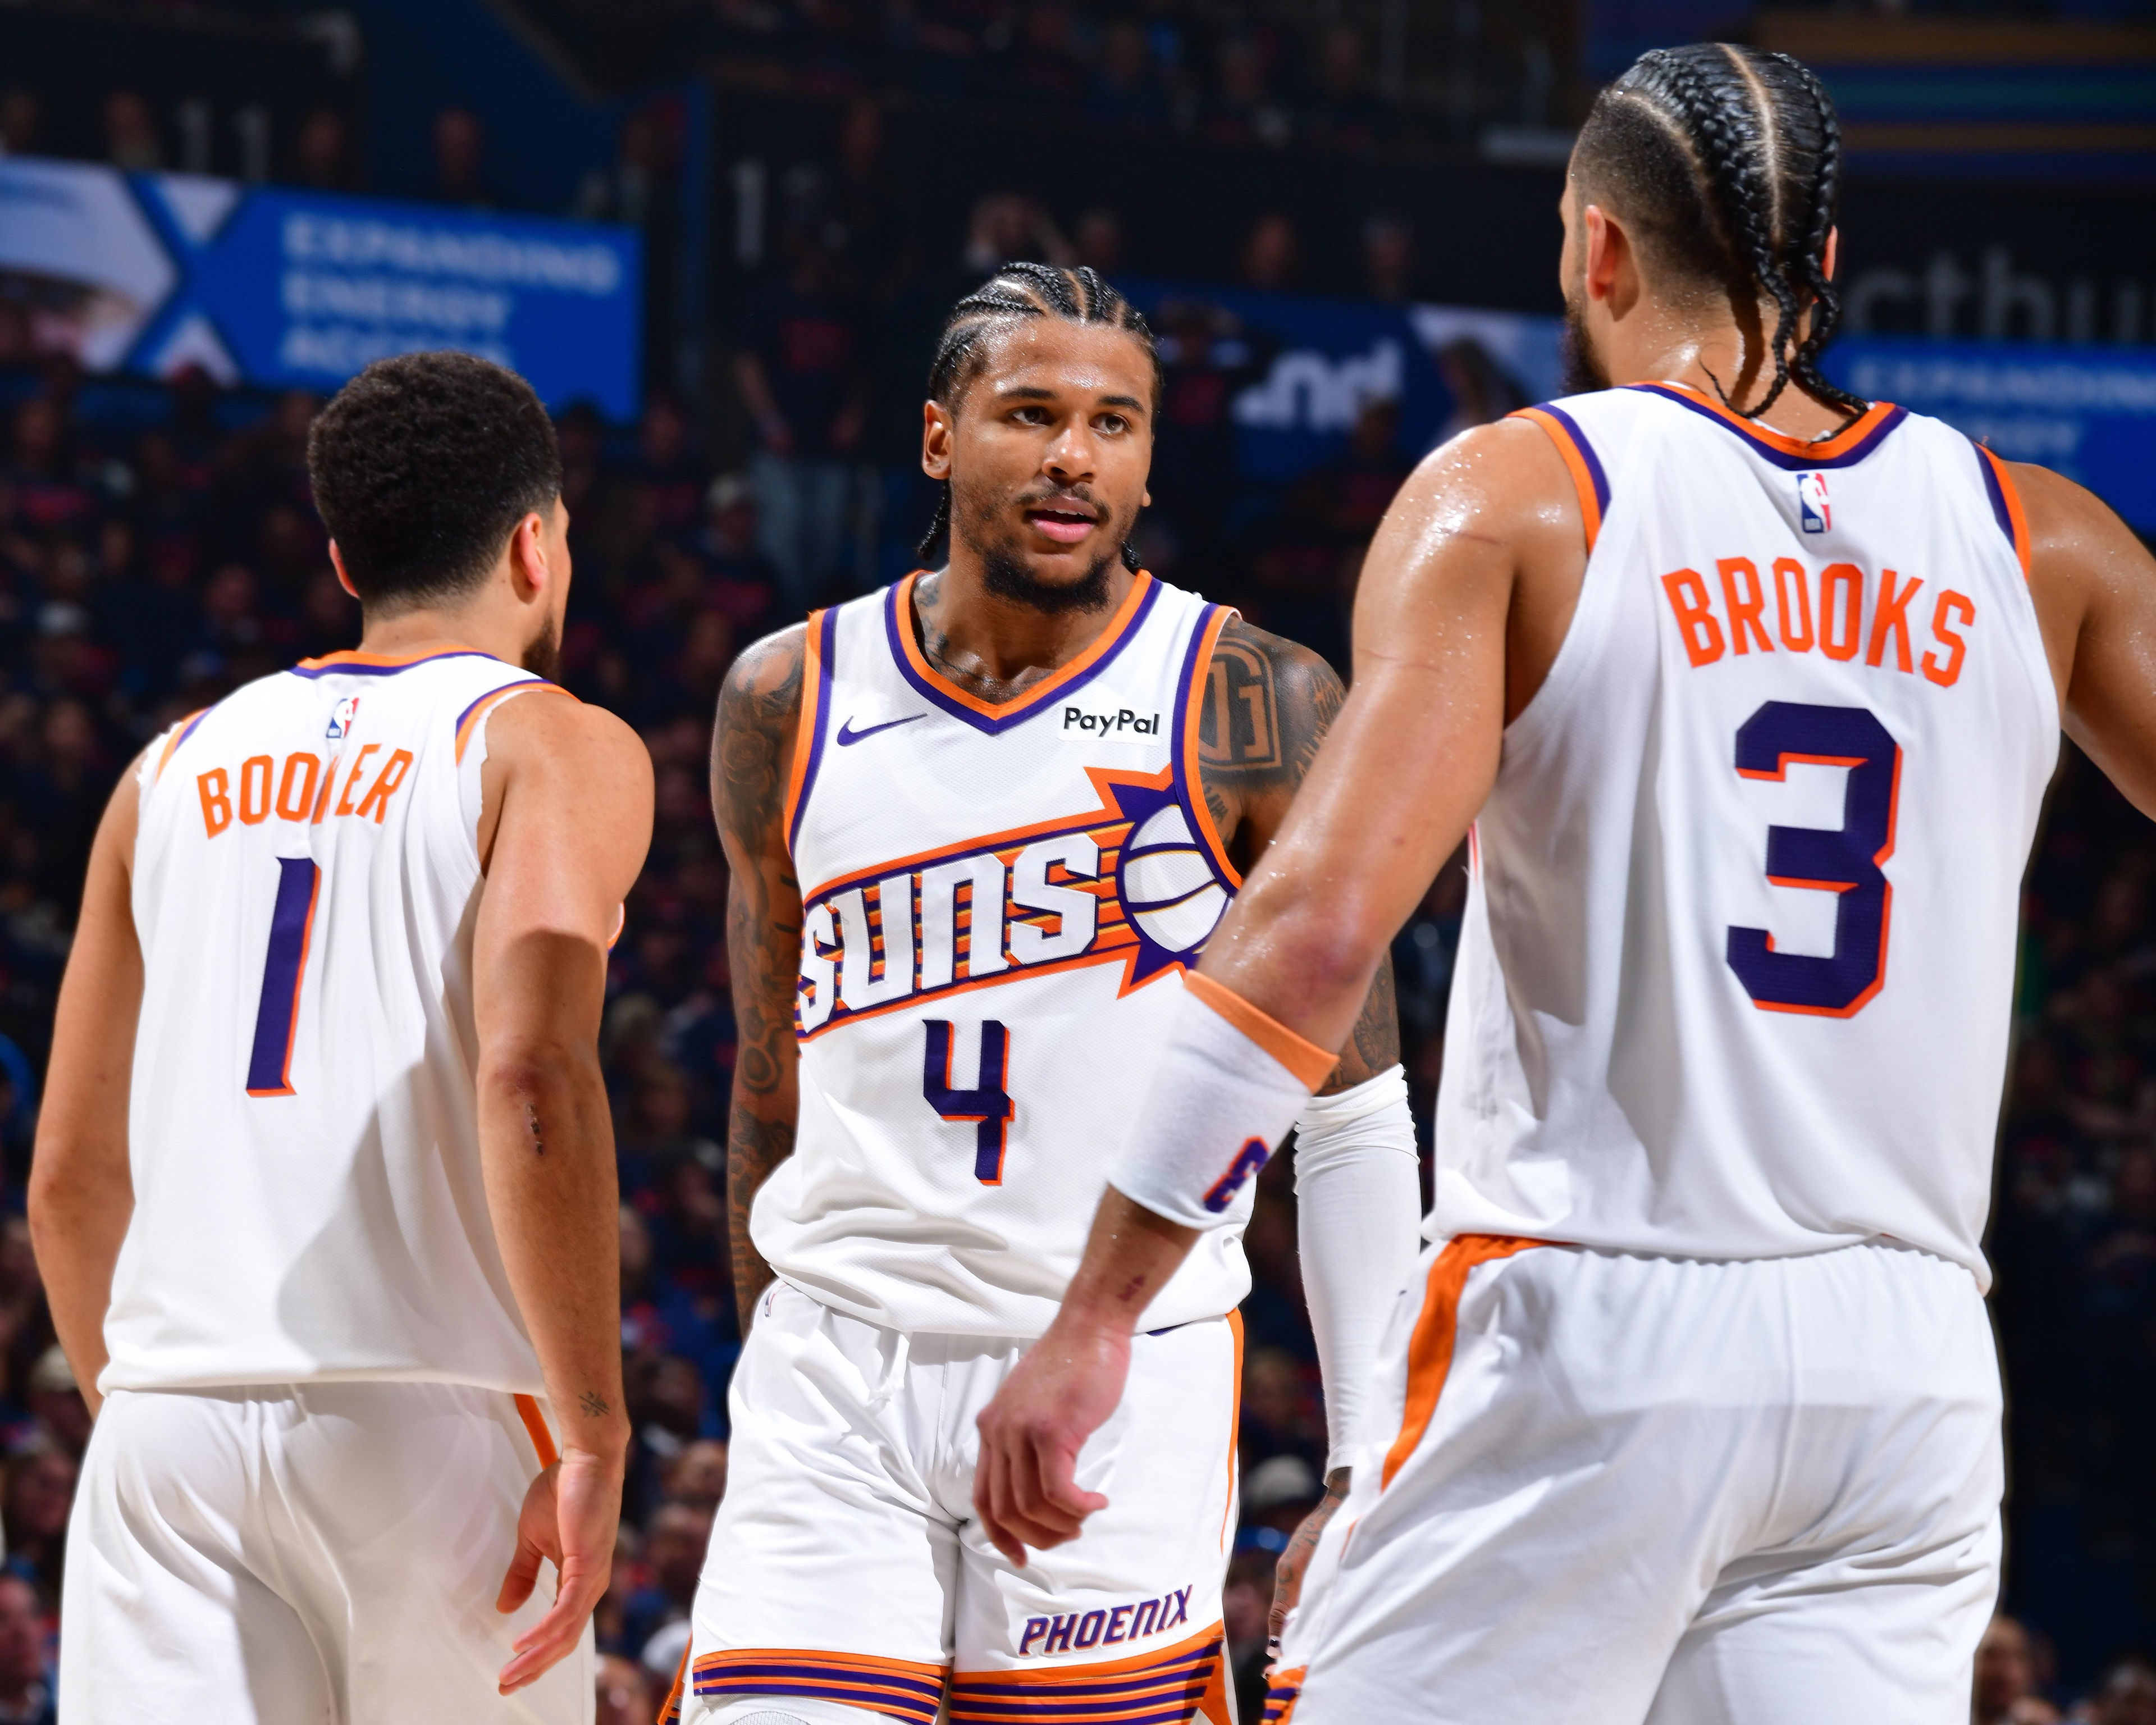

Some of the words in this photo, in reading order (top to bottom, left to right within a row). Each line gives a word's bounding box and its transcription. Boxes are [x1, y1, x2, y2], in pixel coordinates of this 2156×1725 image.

[1660, 556, 1976, 688] BROOKS
[1063, 707, 1161, 737] PayPal
[798, 832, 1102, 1037] SUNS
[1726, 700, 1903, 1019] 3
[245, 856, 322, 1098] 1
[922, 1019, 1016, 1186] 4
[1017, 1583, 1193, 1657] PHOENIX
